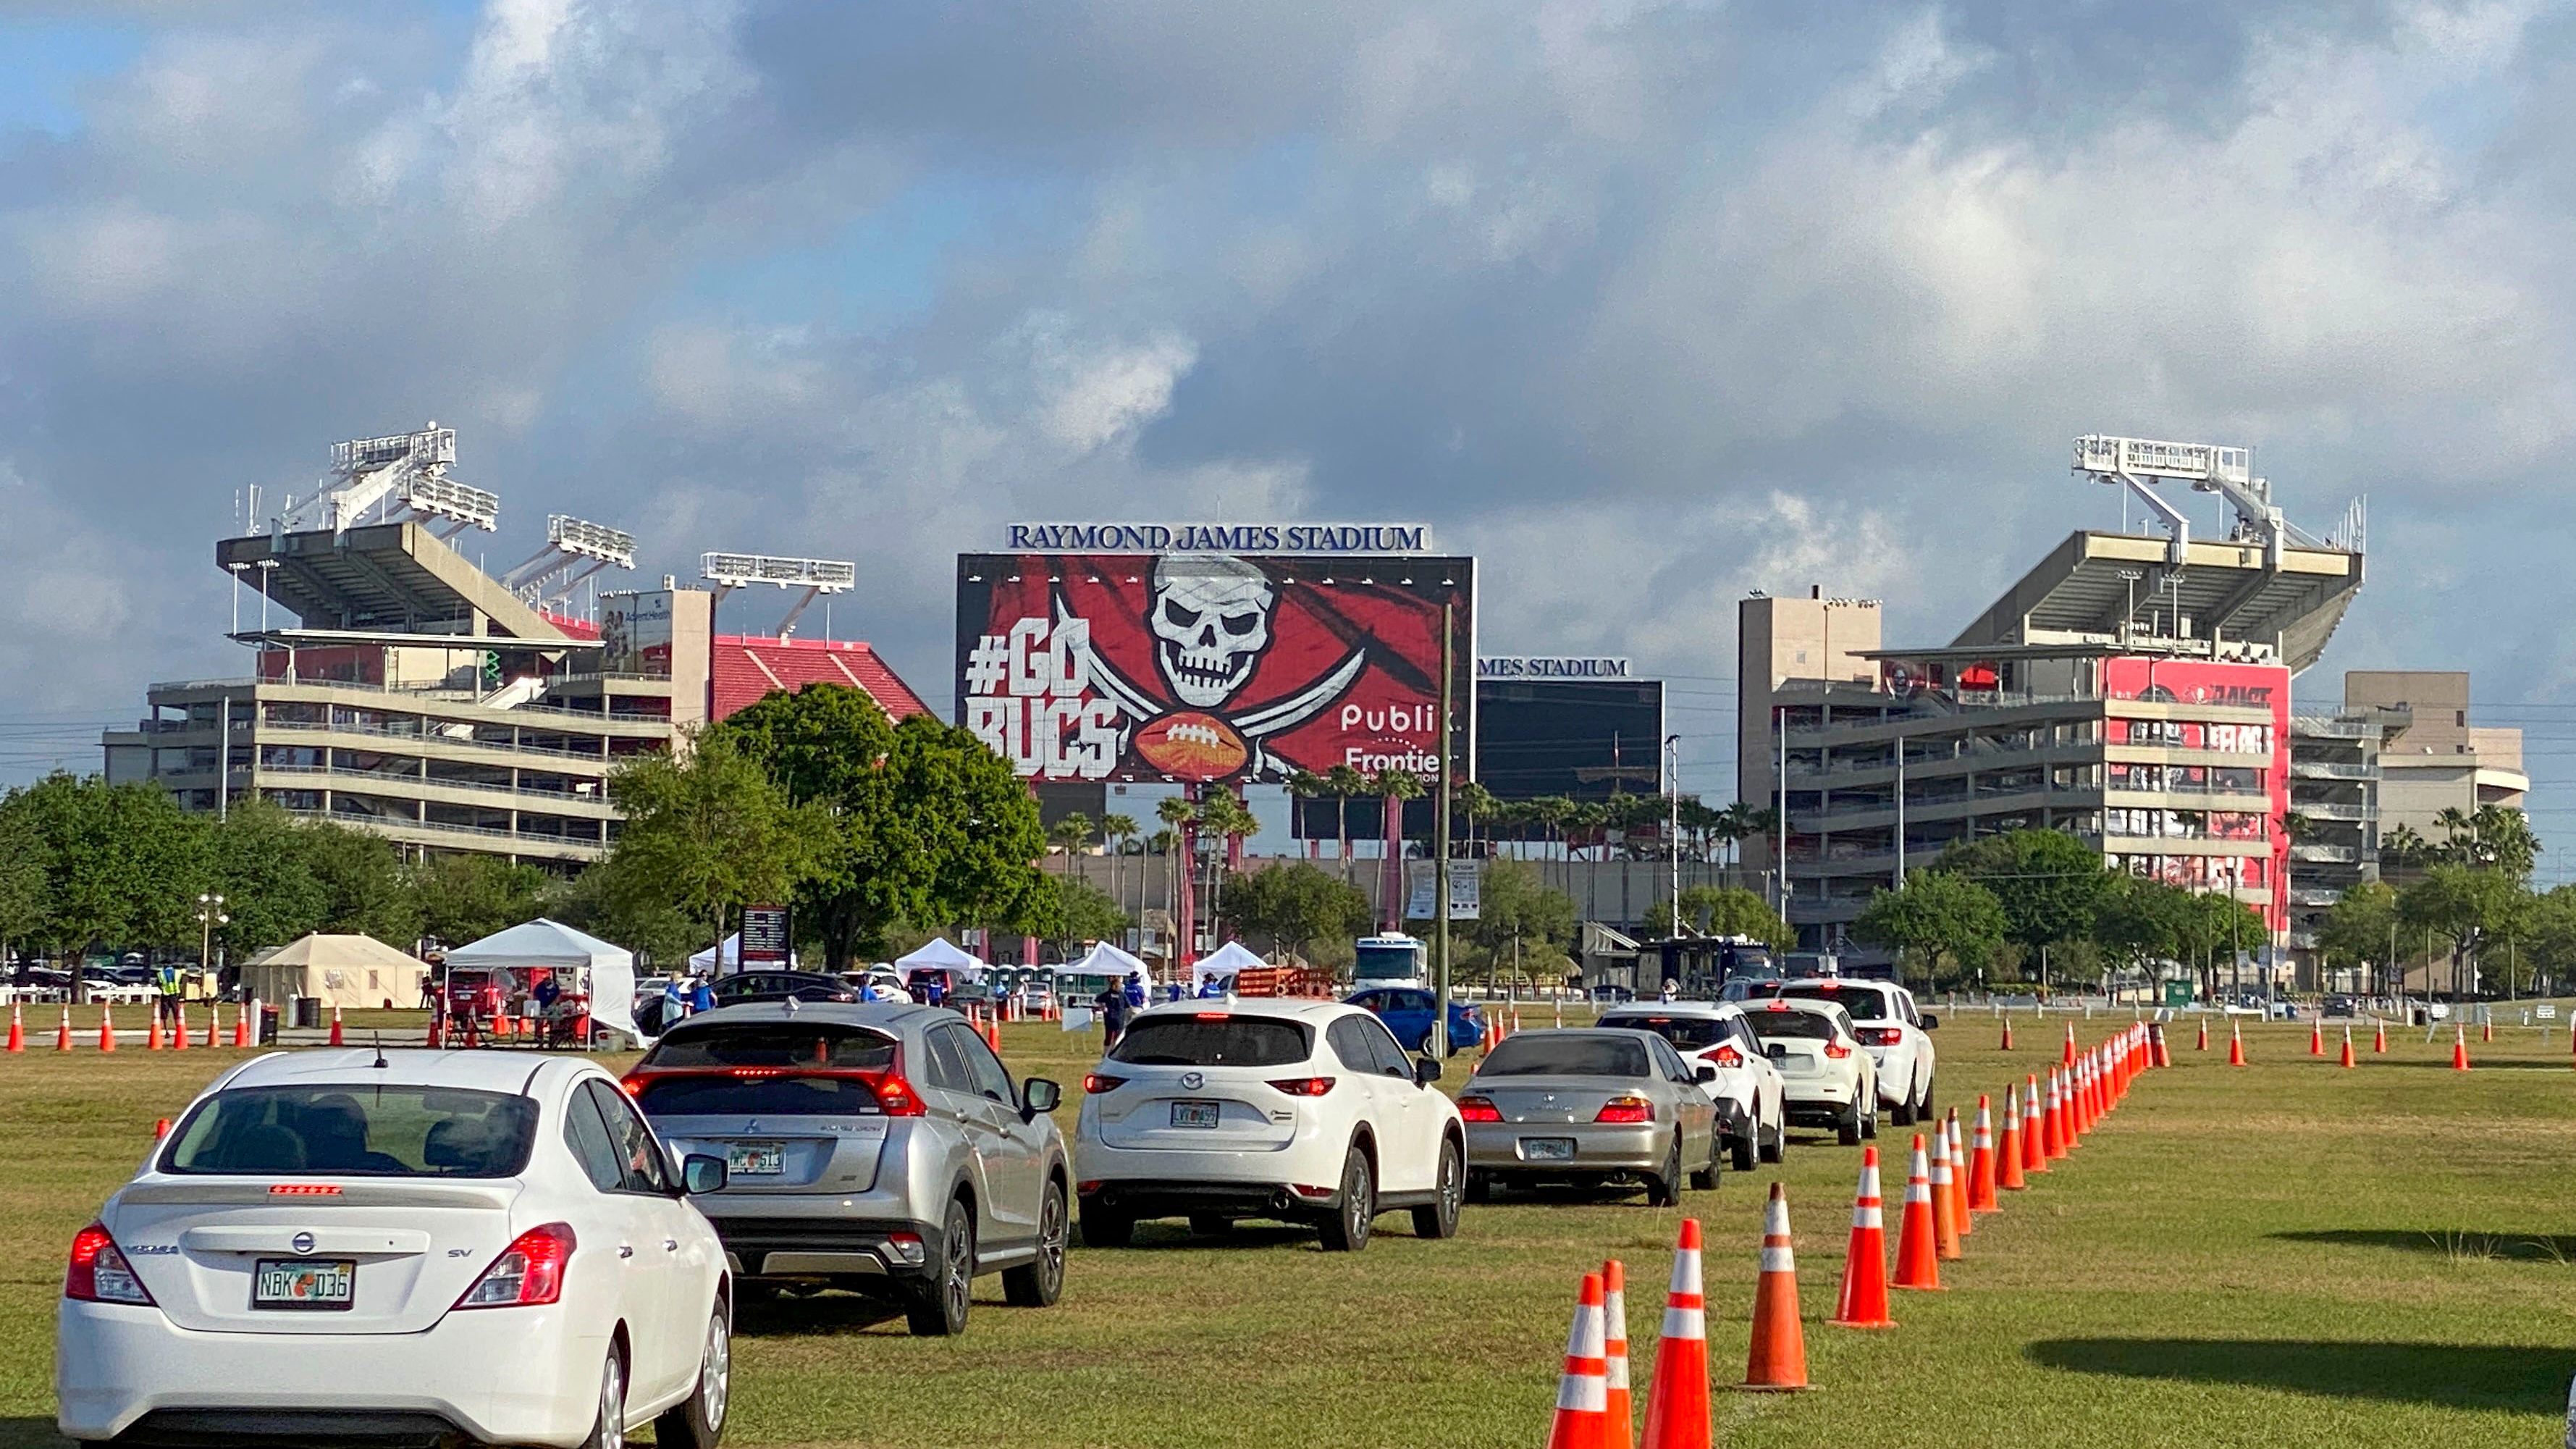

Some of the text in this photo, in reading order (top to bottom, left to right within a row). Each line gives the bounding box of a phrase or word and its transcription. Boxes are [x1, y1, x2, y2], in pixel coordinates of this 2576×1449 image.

[1009, 525, 1425, 550] RAYMOND JAMES STADIUM
[964, 617, 1090, 697] #GO
[1477, 658, 1628, 676] MES STADIUM
[964, 697, 1118, 778] BUCS
[1345, 747, 1452, 773] Frontie
[447, 1249, 474, 1258] SV
[260, 1273, 292, 1297] NBK
